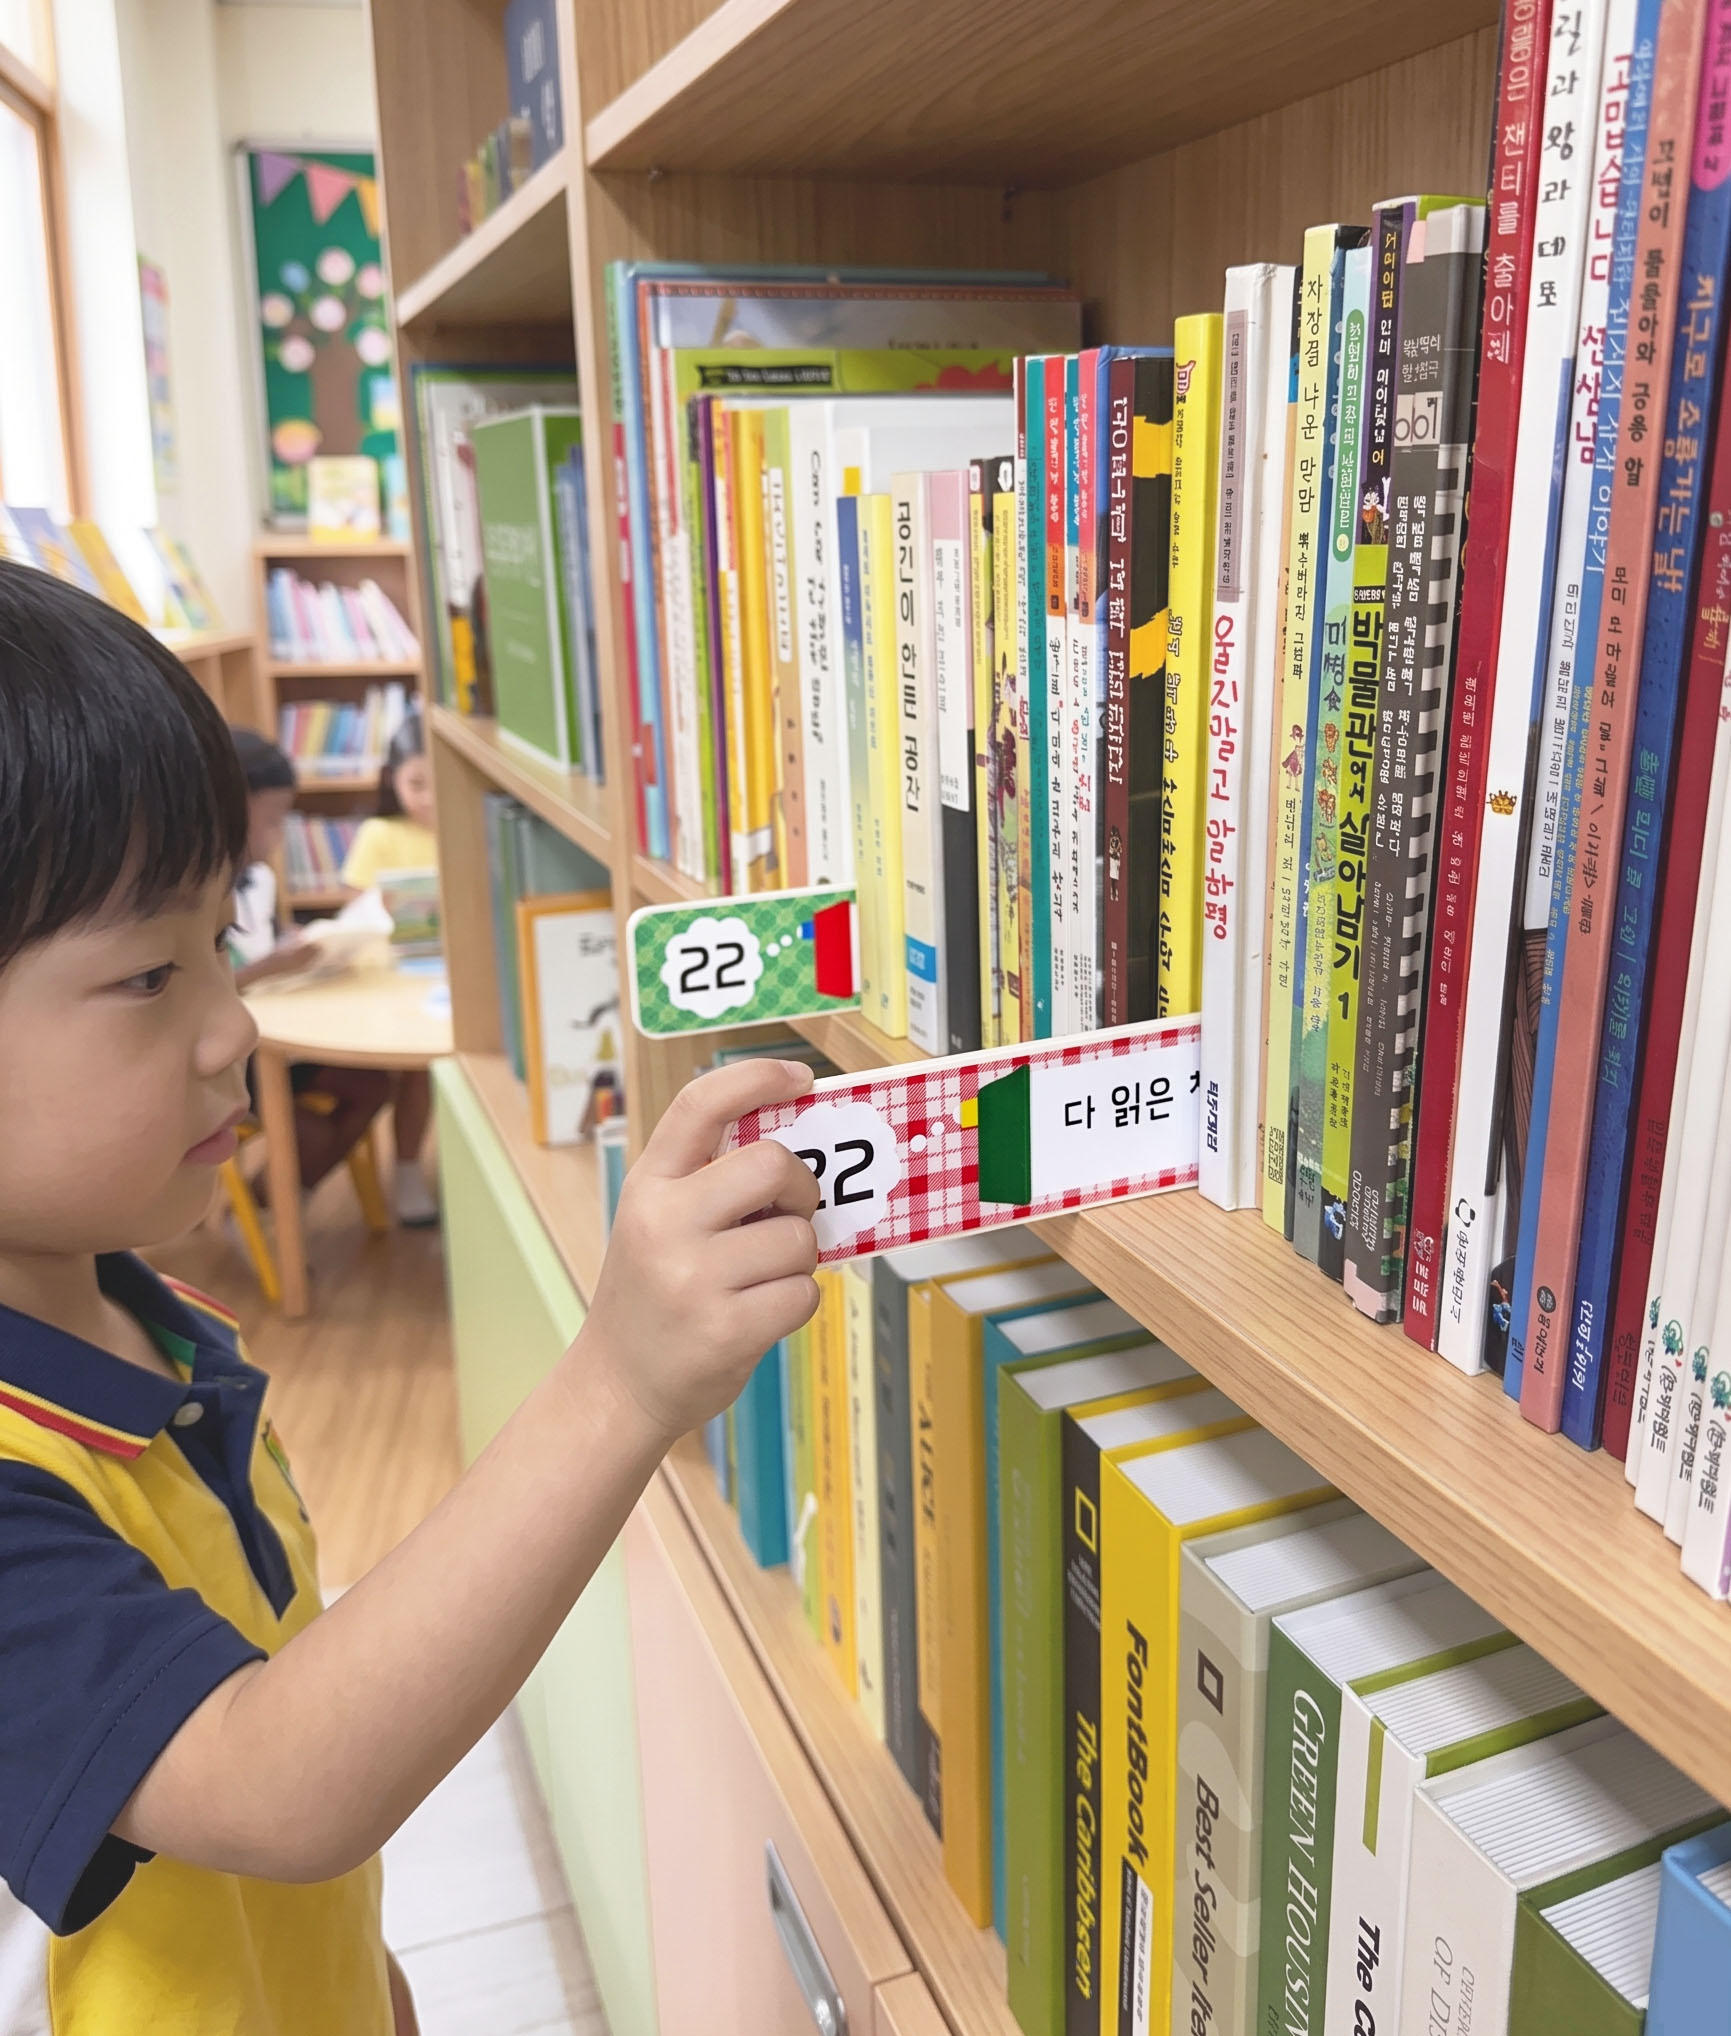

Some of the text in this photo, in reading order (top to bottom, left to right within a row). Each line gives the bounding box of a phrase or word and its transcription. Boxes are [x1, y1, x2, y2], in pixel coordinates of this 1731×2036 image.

[679, 942, 746, 993] 22
[1064, 1095, 1095, 1131] 다
[1111, 1077, 1174, 1129] 읽은
[1074, 1710, 1097, 1787] The
[1126, 1618, 1150, 1873] FontBook
[1291, 1688, 1327, 1870] GREEN
[1190, 1773, 1221, 2036] Best Seller Ite
[1356, 1915, 1381, 1993] The
